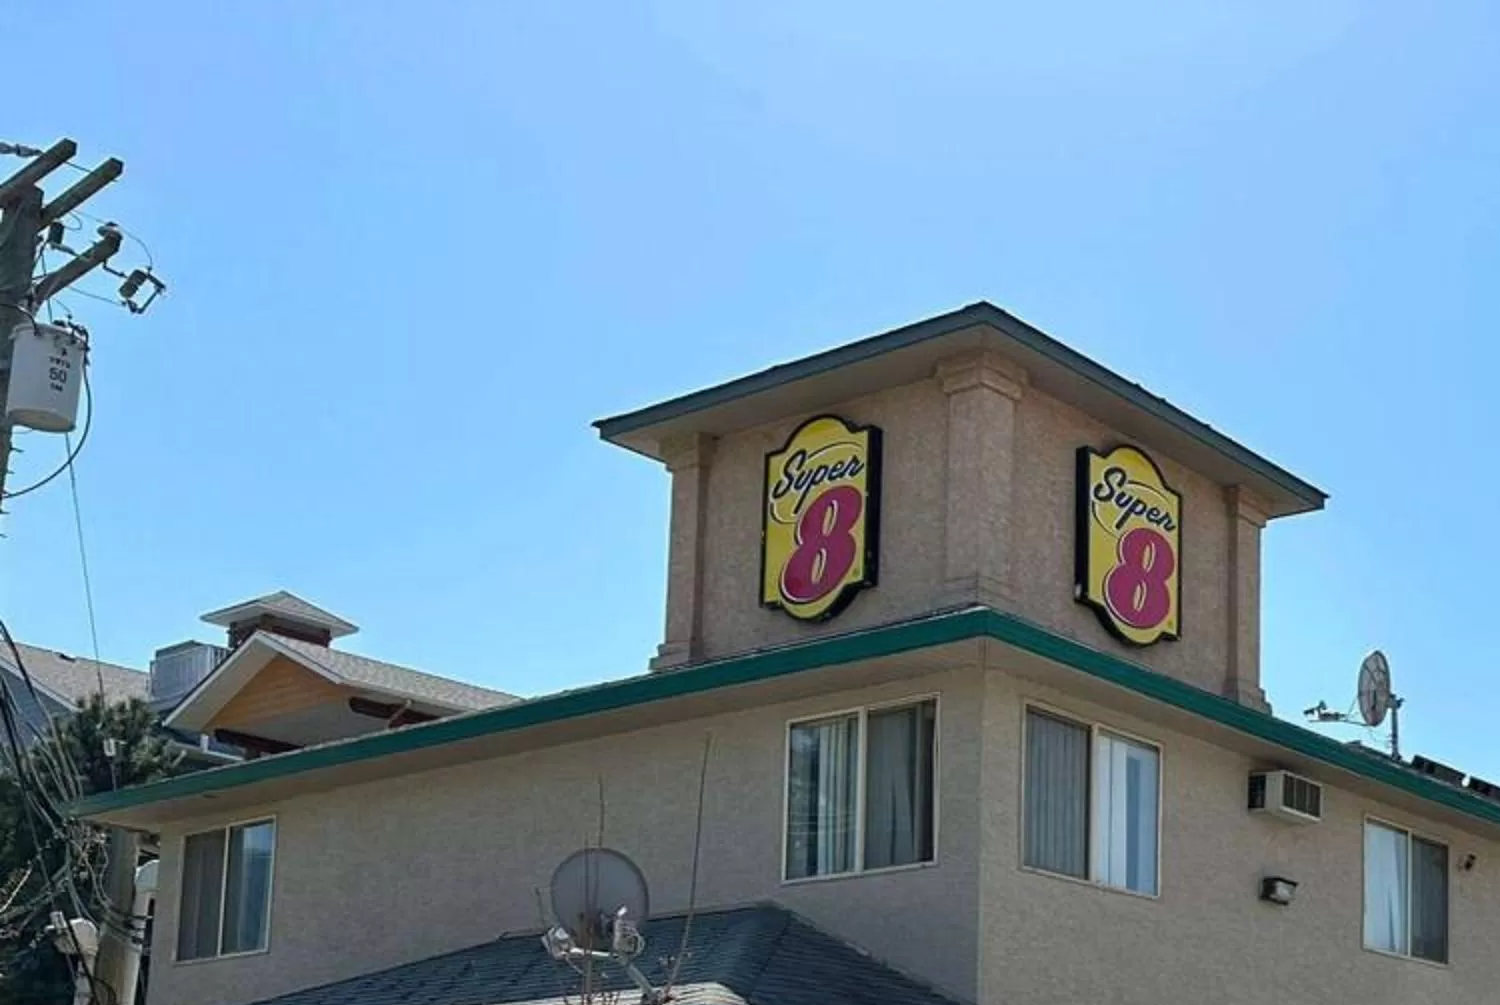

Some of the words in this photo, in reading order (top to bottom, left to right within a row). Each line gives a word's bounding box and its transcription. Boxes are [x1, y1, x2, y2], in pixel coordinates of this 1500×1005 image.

[773, 449, 865, 515] Super
[1093, 466, 1177, 532] Super
[779, 484, 863, 604] 8
[1103, 527, 1175, 629] 8
